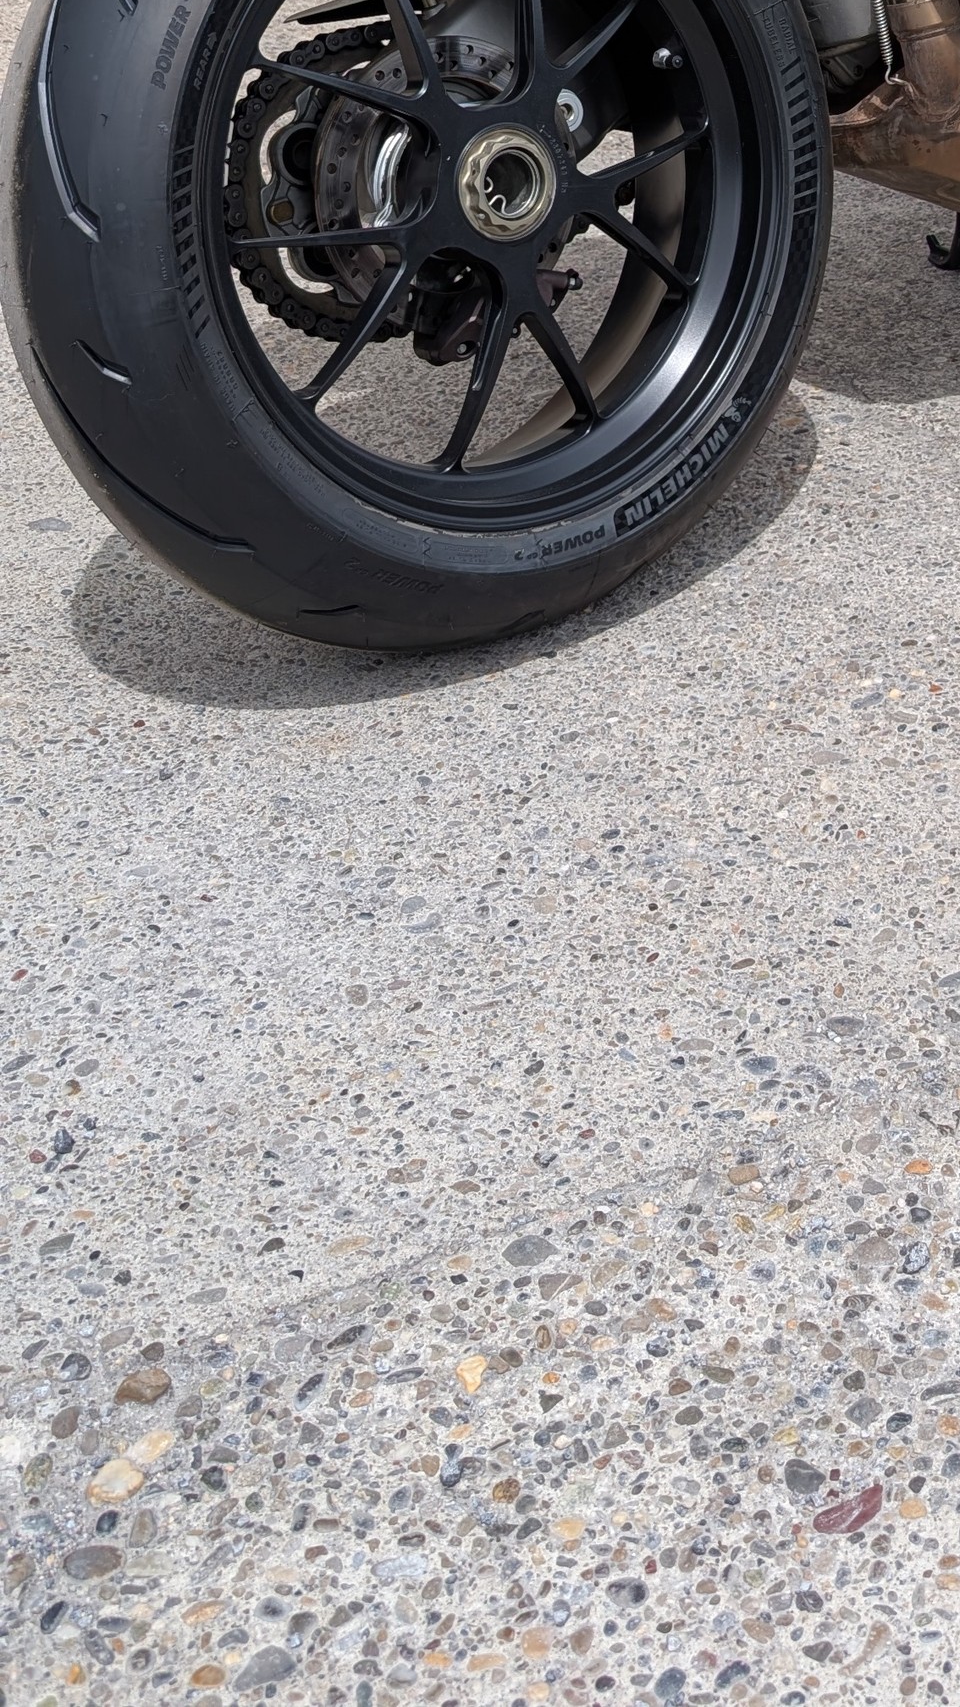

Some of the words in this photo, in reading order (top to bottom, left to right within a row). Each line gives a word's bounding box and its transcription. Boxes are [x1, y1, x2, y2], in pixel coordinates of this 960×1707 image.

[150, 4, 192, 91] POWER
[193, 46, 212, 90] REAR
[624, 421, 731, 526] MICHELIN
[513, 548, 526, 561] 2
[541, 524, 606, 558] POWER
